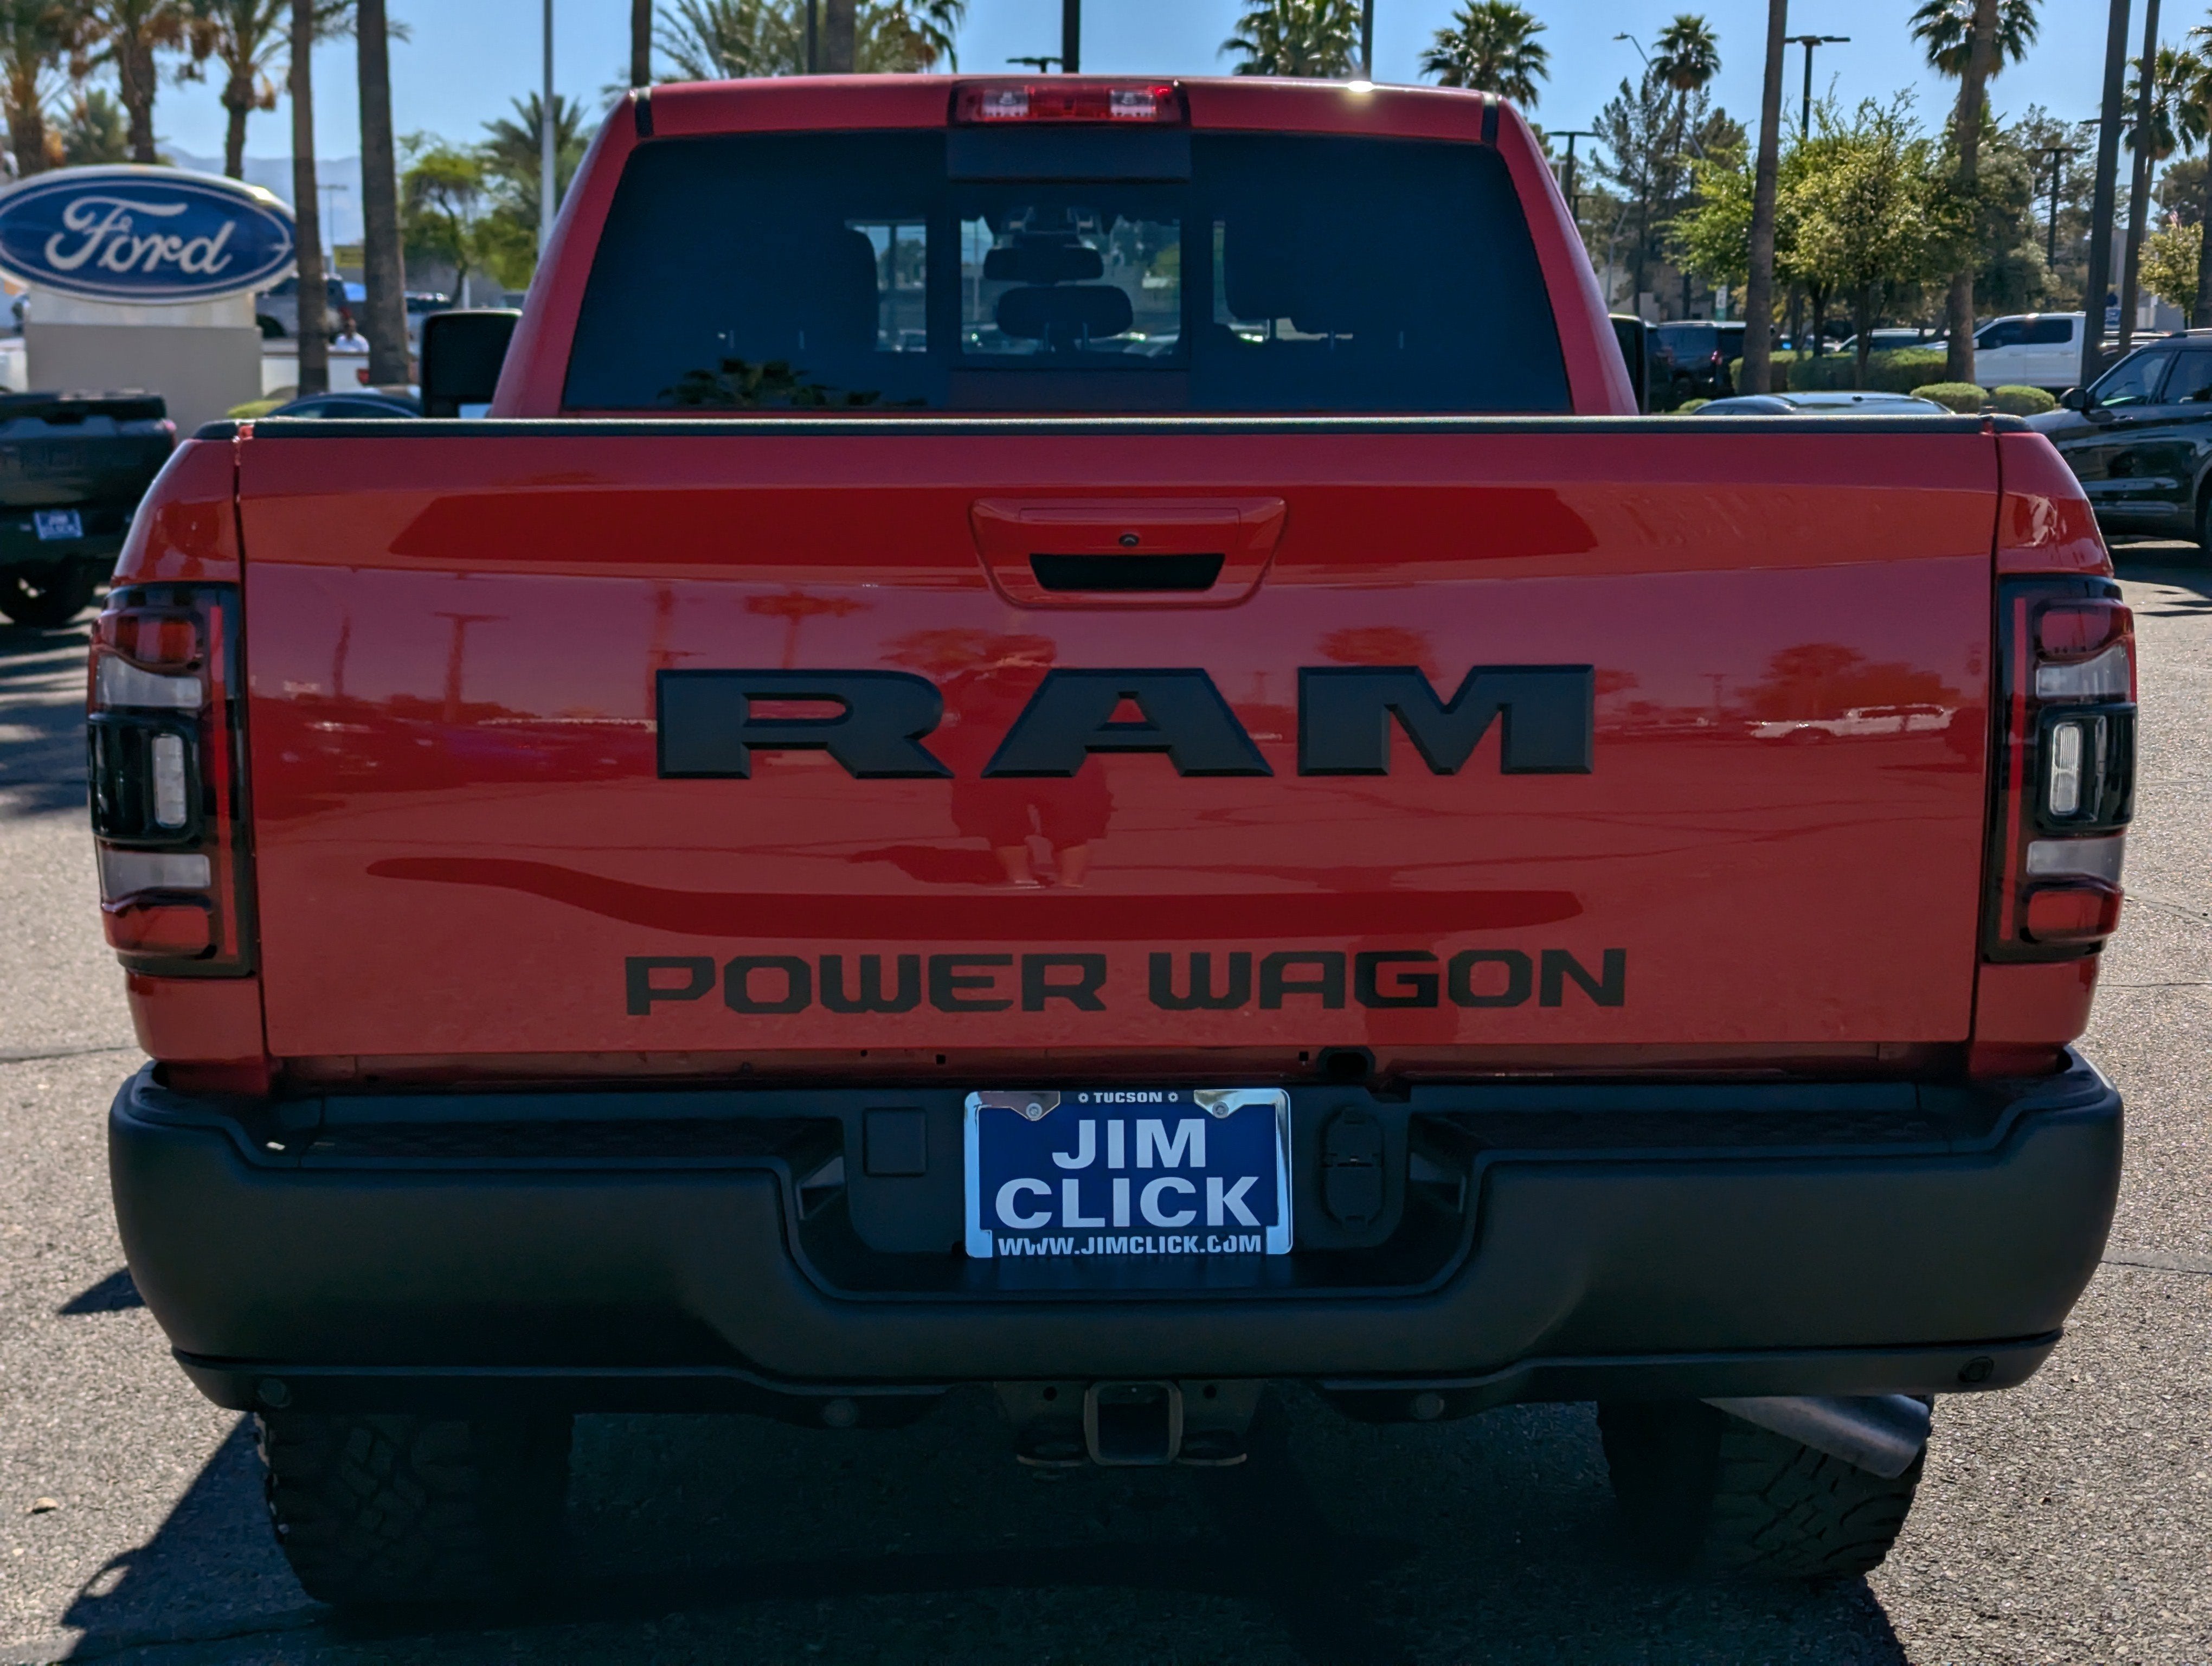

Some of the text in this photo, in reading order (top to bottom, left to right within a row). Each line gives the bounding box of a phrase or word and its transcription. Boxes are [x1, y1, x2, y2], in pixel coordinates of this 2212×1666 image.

[46, 196, 236, 274] Ford
[656, 665, 1594, 779] RAM
[626, 949, 1627, 1015] POWER WAGON
[1094, 1092, 1162, 1104] TUCSON
[1052, 1119, 1206, 1169] JIM
[995, 1176, 1261, 1228] CLICK
[998, 1235, 1262, 1255] WWW.JIMCLICK.COM
